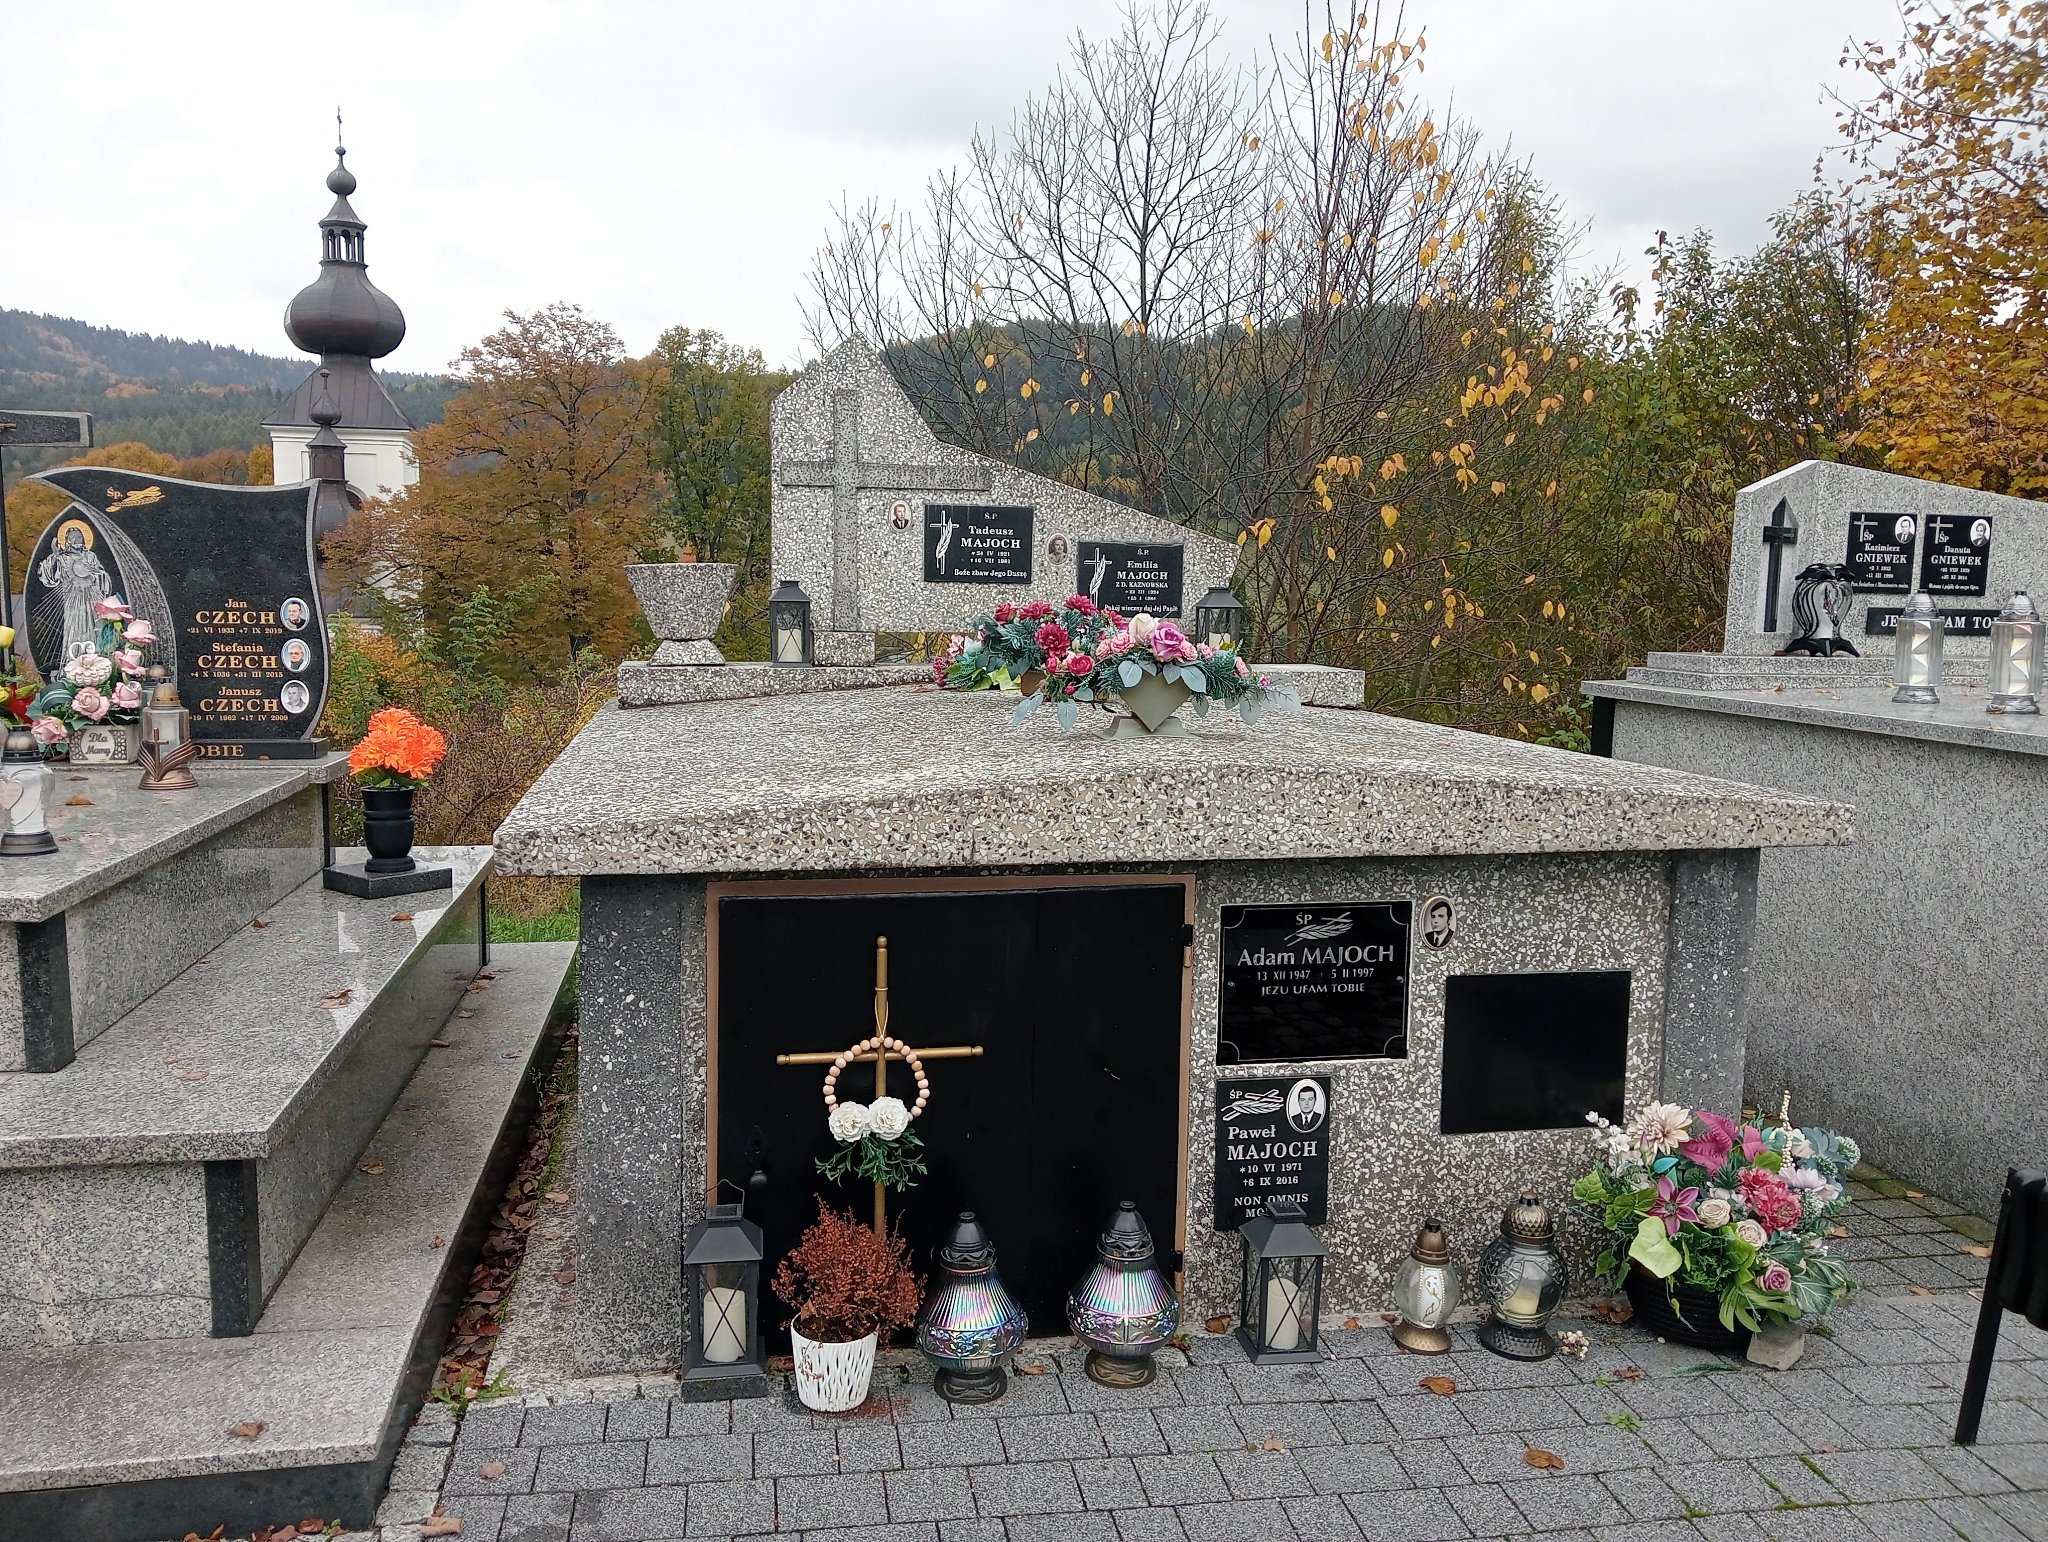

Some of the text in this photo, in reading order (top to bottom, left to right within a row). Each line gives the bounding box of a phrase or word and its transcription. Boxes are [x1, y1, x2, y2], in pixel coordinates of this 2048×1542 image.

[968, 525, 1014, 536] Tadeusz
[960, 537, 1021, 549] MAJOCH
[1864, 542, 1901, 552] Kazimierz
[1944, 545, 1971, 554] Danuta
[1855, 552, 1908, 564] GNIEWEK
[1931, 554, 1982, 566] GNIEWEK
[1126, 560, 1159, 569] Emilia
[990, 570, 1006, 578] Jego
[1007, 569, 1028, 579] Duszę
[1116, 571, 1169, 580] MAJOCH
[225, 598, 248, 608] Jan
[1121, 604, 1143, 612] wieczny
[1143, 604, 1153, 613] daj
[1153, 604, 1162, 613] Jej
[195, 611, 276, 625] CZECH
[1881, 614, 1899, 627] JE
[212, 642, 264, 653] Stefania
[198, 655, 279, 669] CZECH
[218, 686, 262, 696] Janusz
[200, 698, 280, 712] CZECH
[89, 732, 108, 743] Dla
[85, 744, 111, 757] Mamy
[194, 744, 244, 757] OBIE
[1296, 912, 1313, 925] ŚP
[1238, 945, 1394, 967] Adam MAJOCH
[1257, 968, 1375, 981] 13 XII 1947 5 II 1997
[1261, 982, 1366, 997] JEZU UFAM TOBIE
[1229, 1089, 1243, 1099] ŚP
[1228, 1125, 1277, 1140] Paweł
[1227, 1141, 1318, 1161] MAJOCH
[1263, 1163, 1276, 1172] VI
[1281, 1163, 1302, 1172] 1971
[1260, 1177, 1271, 1186] IX
[1276, 1176, 1299, 1185] 2016
[1234, 1196, 1261, 1207] NON
